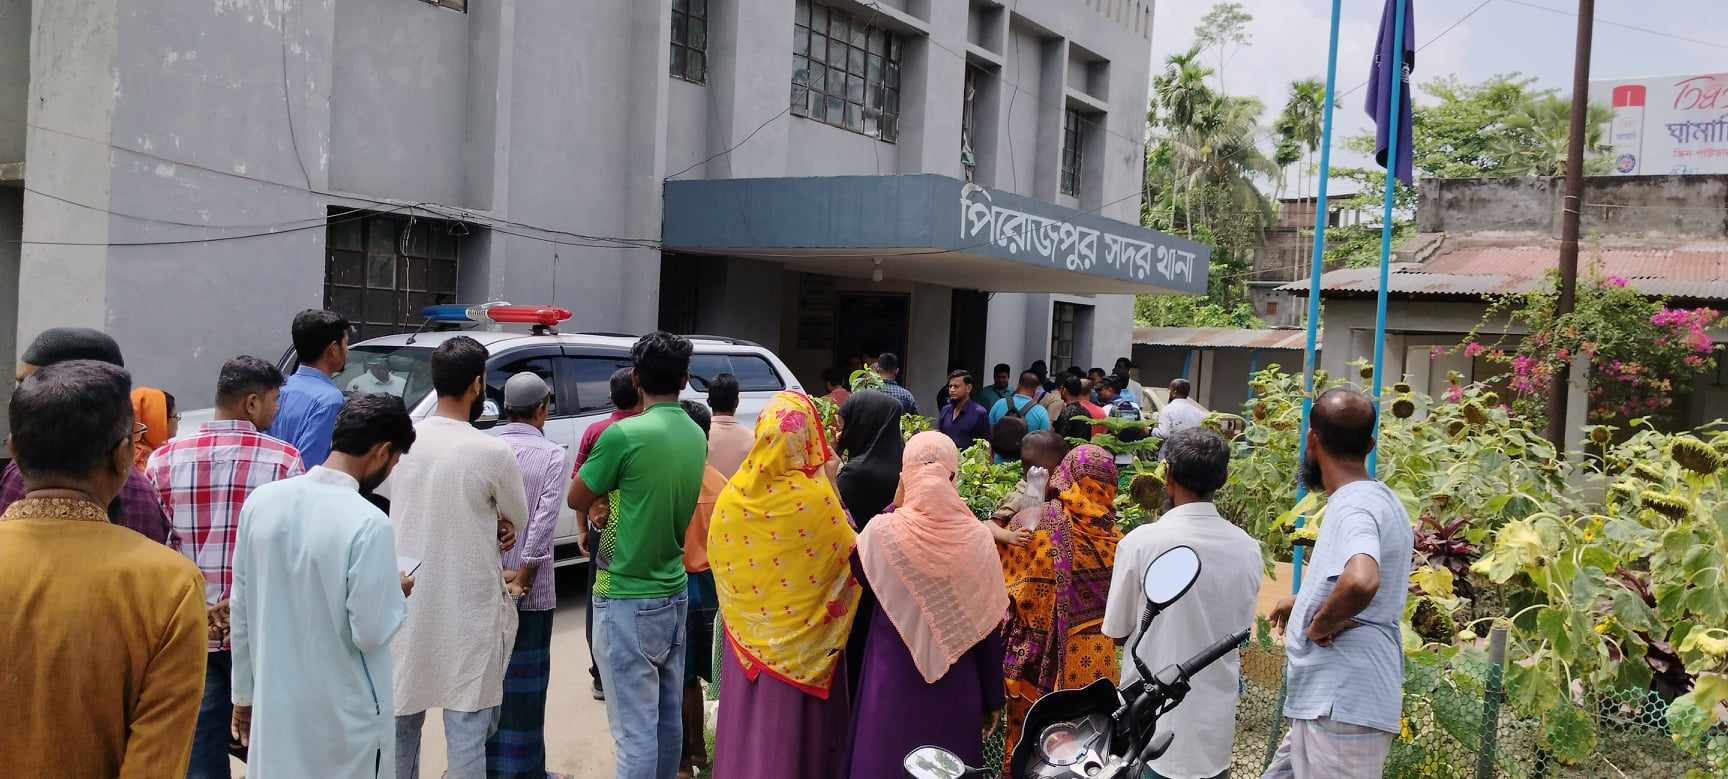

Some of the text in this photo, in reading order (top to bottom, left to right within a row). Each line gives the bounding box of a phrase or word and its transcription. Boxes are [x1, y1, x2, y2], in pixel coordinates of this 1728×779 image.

[960, 183, 1196, 283] পিরোজপুর সদর থানা
